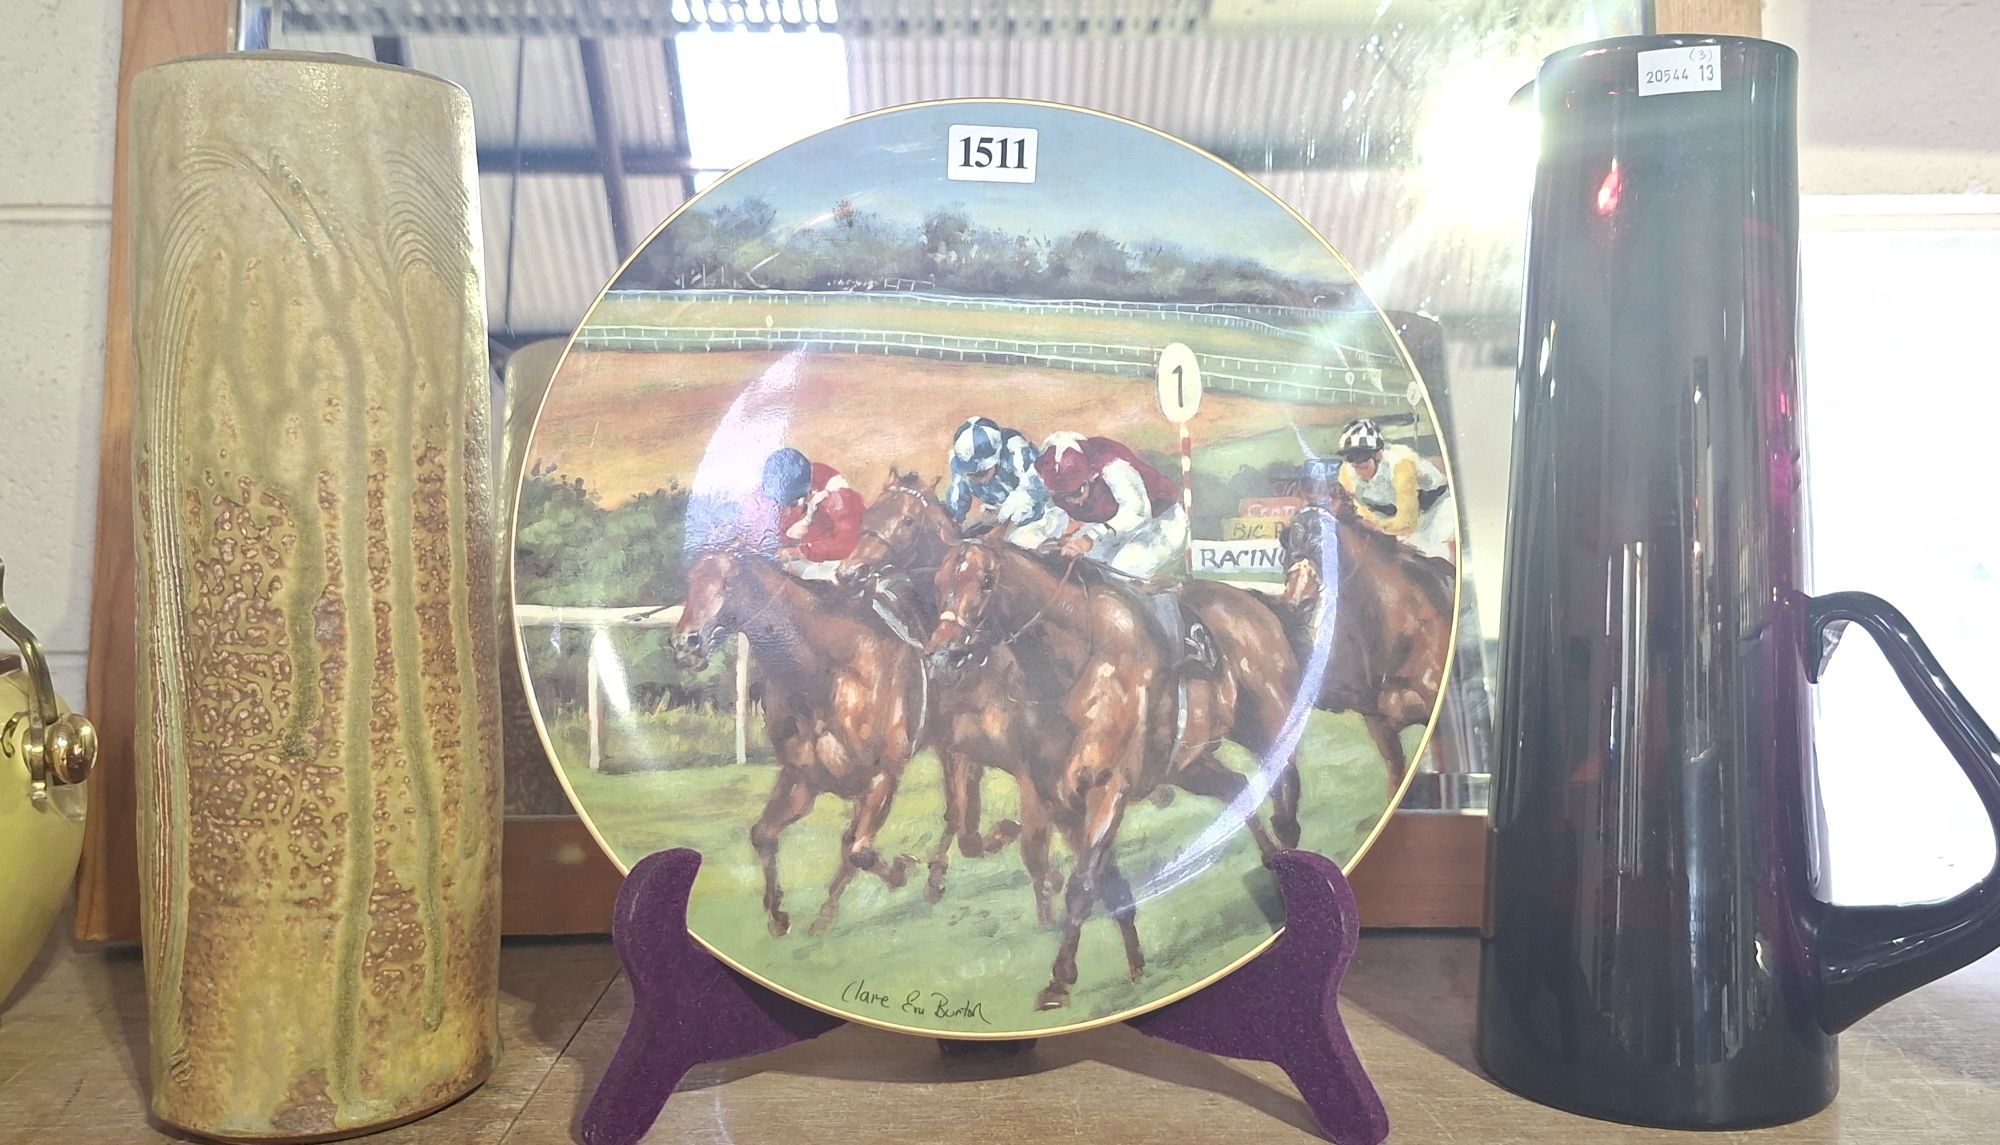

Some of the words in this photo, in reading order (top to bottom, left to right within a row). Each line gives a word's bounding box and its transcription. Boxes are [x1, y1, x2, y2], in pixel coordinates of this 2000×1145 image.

[1689, 47, 1713, 63] (3)
[1646, 68, 1689, 84] 20544
[1699, 64, 1714, 81] 13
[958, 136, 1029, 169] 1511
[1172, 364, 1184, 408] 1
